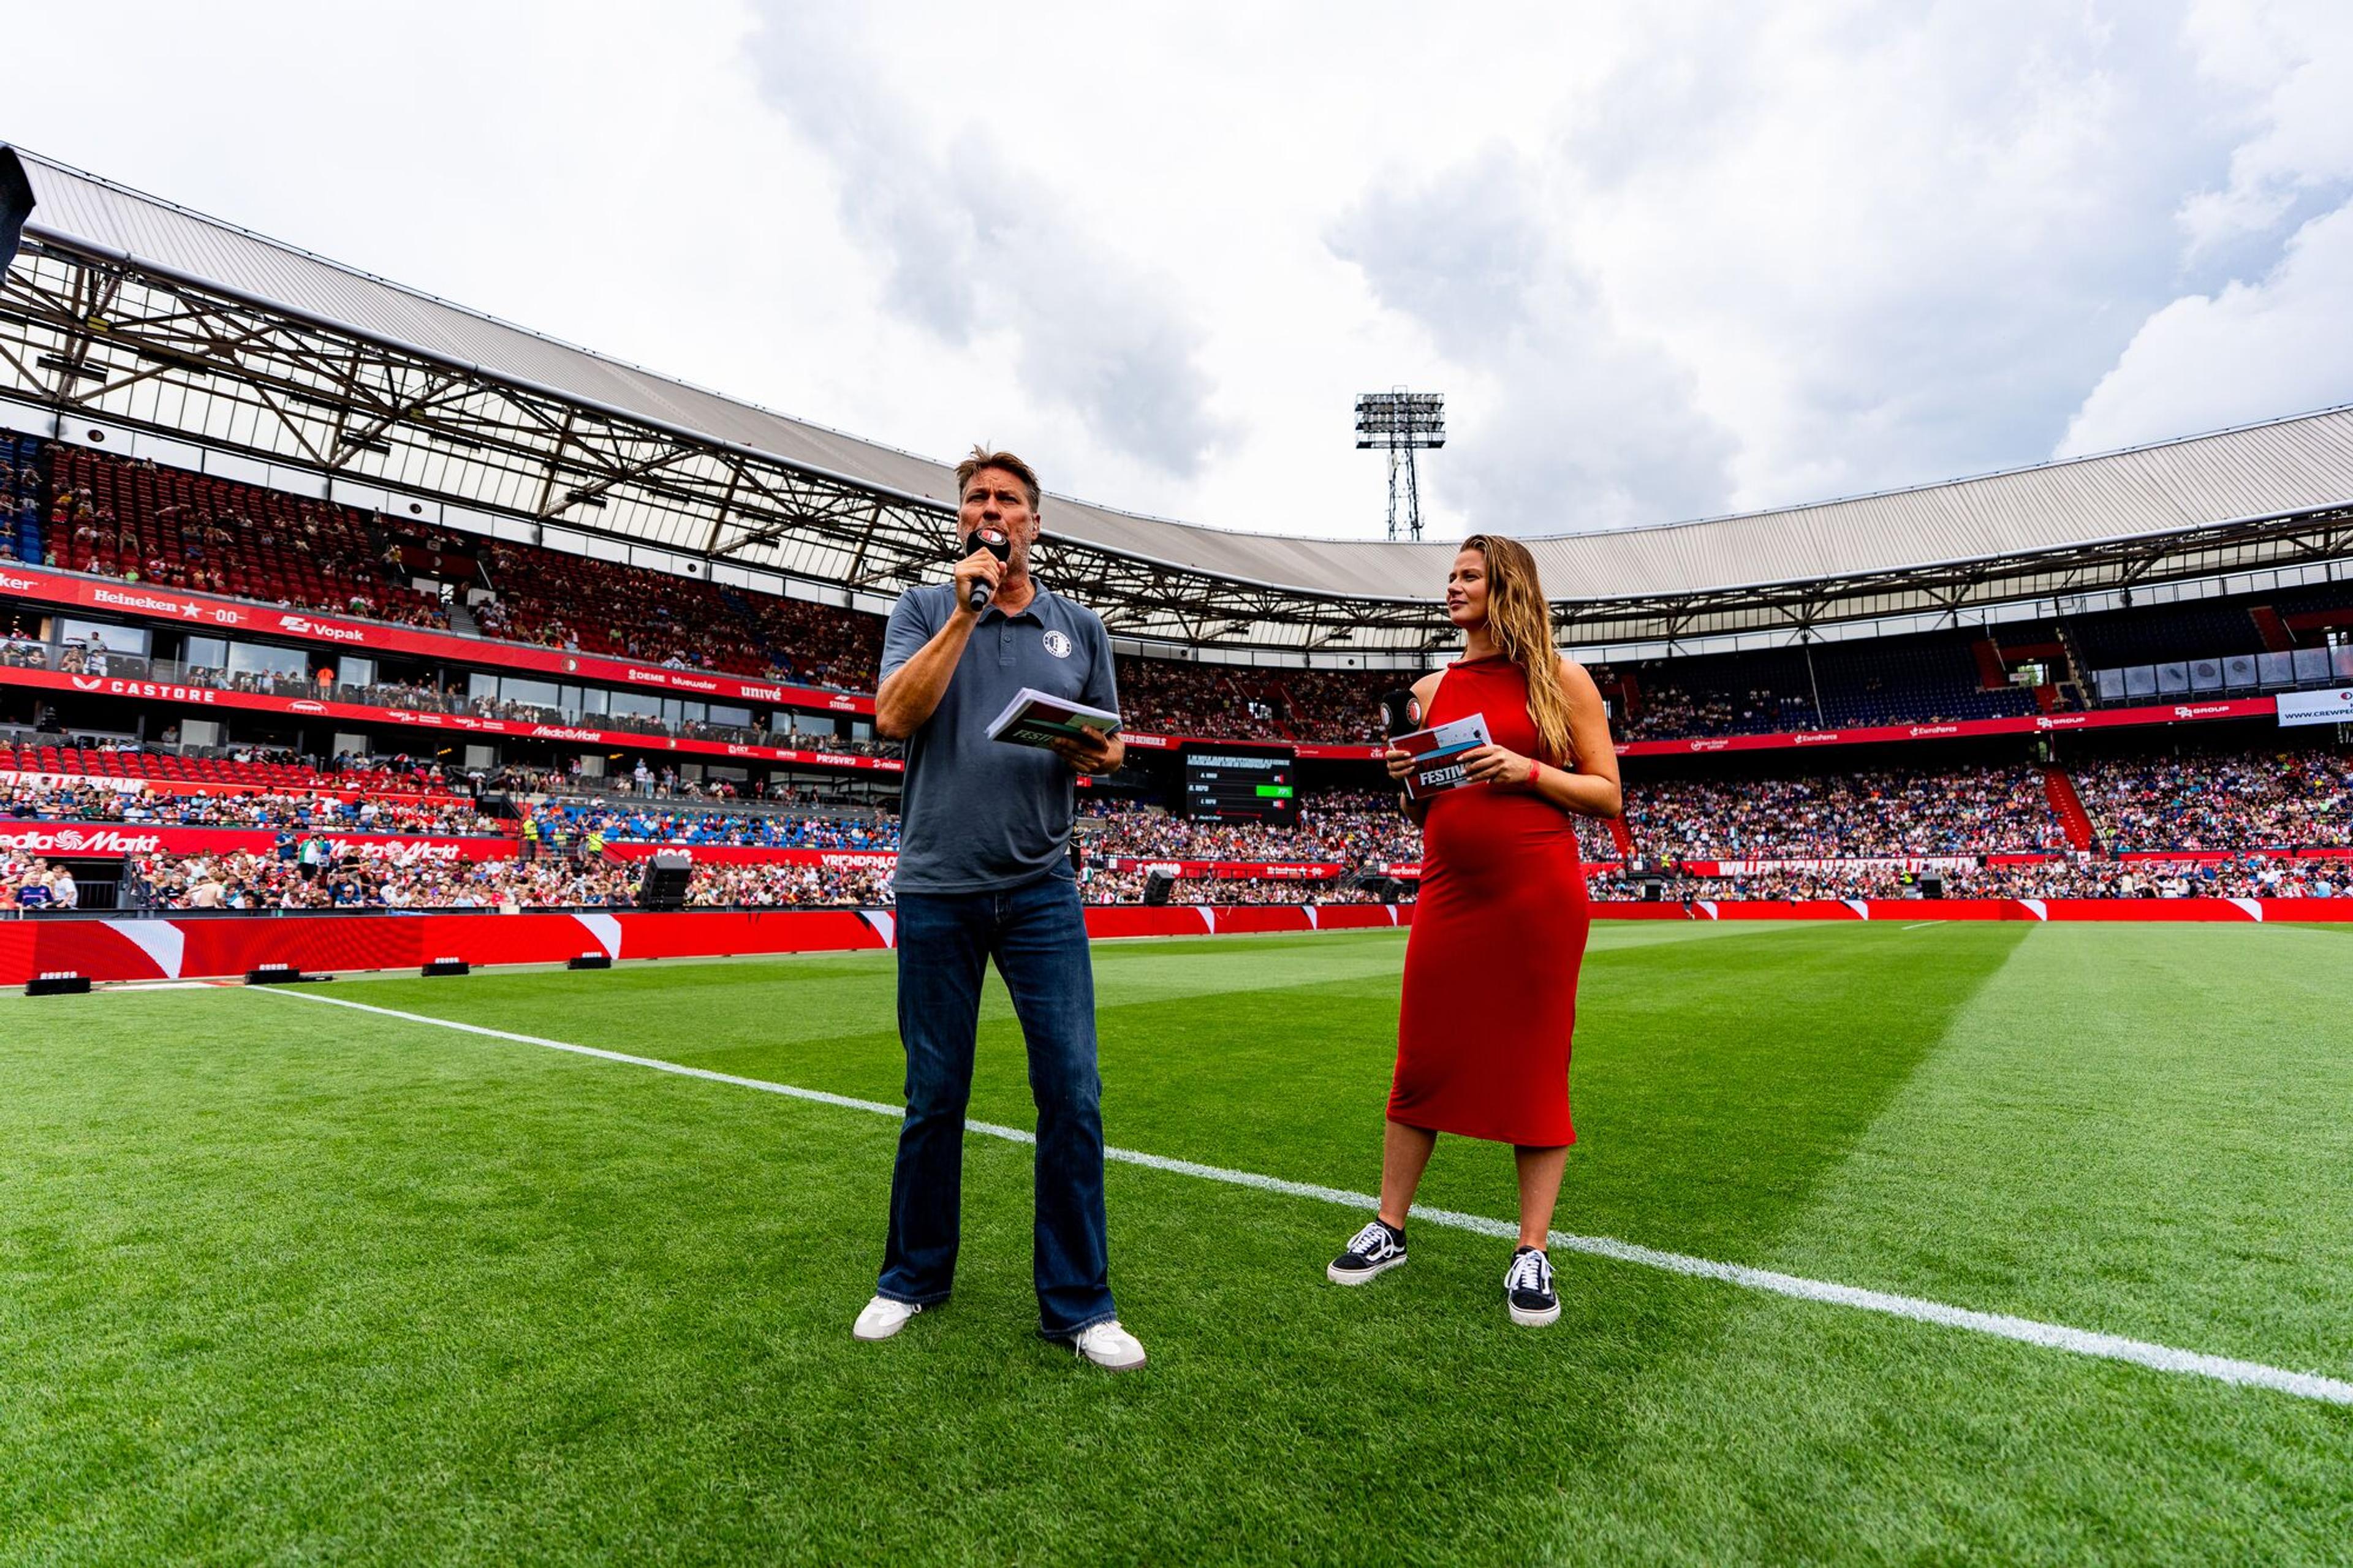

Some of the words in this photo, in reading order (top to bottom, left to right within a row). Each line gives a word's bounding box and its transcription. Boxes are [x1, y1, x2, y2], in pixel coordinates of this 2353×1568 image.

[94, 589, 178, 612] Heineken
[314, 623, 364, 642] Vopak
[111, 681, 214, 702] CASTORE
[78, 831, 160, 852] Markt
